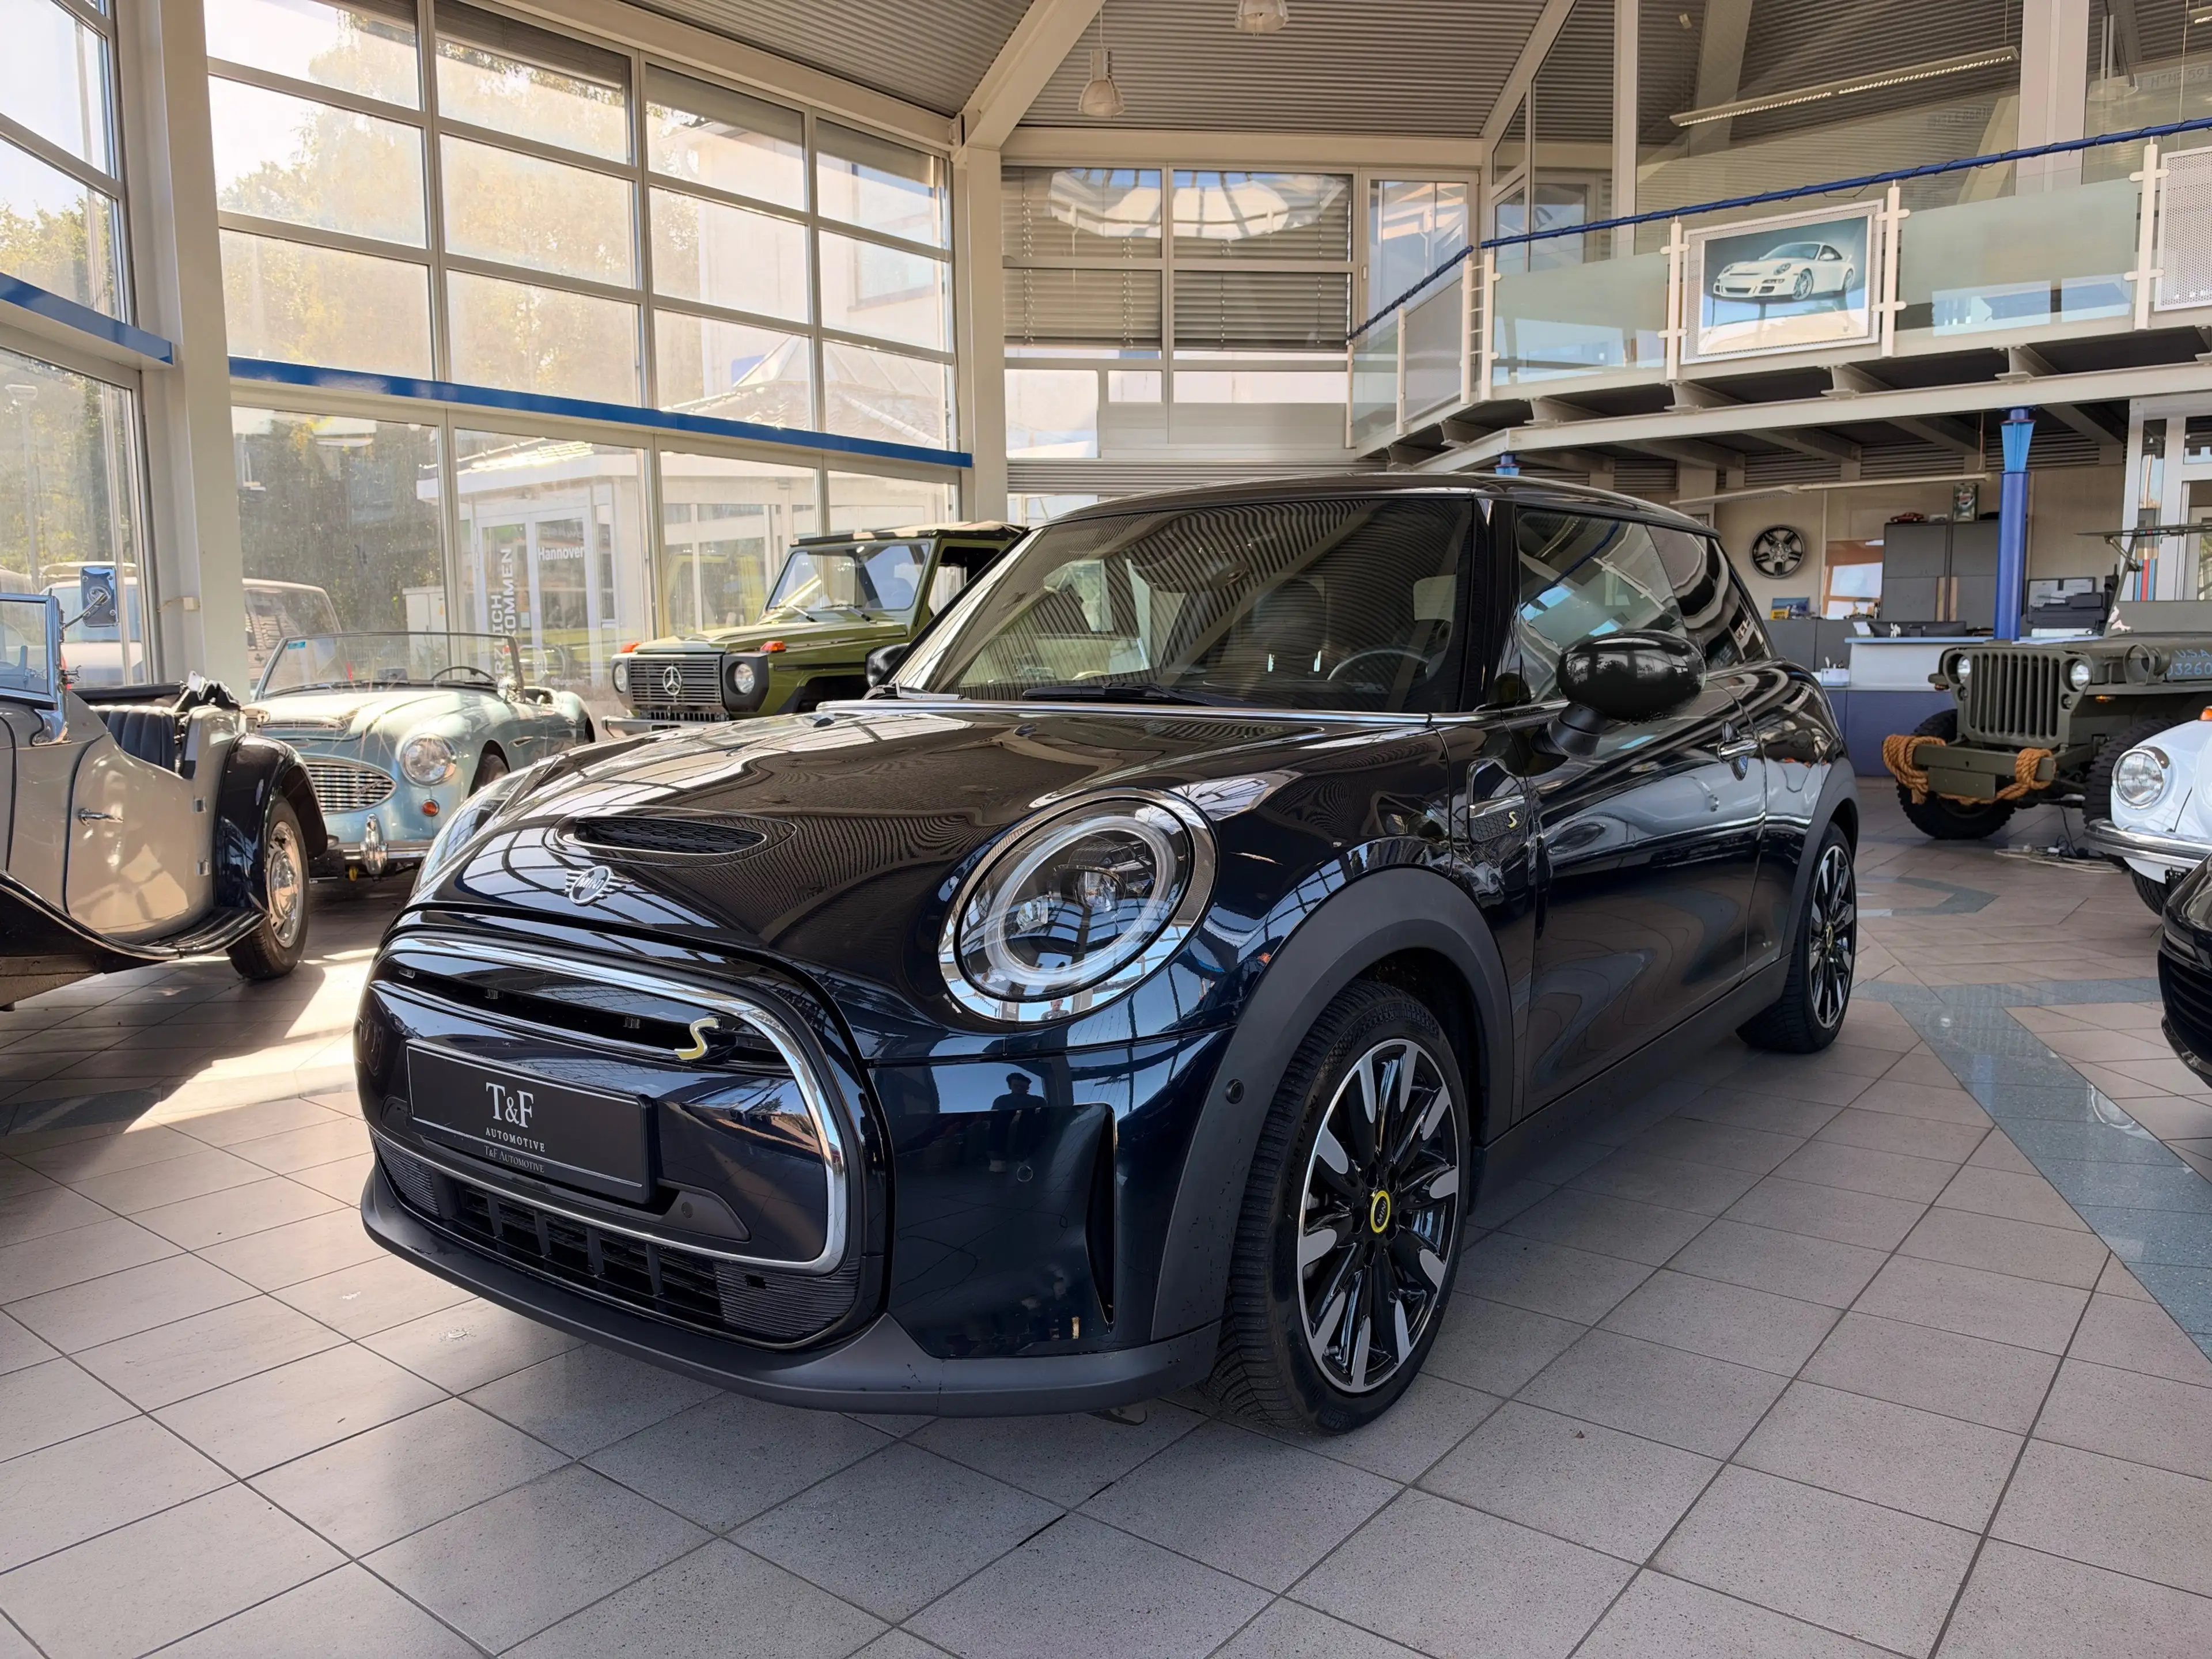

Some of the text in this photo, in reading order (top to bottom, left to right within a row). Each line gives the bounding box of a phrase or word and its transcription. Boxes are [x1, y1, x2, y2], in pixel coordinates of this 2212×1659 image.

[537, 545, 584, 560] Hannover
[1507, 810, 1518, 828] S
[575, 877, 604, 890] MINI
[674, 1017, 720, 1060] S
[486, 1082, 534, 1128] T&F
[486, 1127, 546, 1153] AUTOMOTIVE
[484, 1145, 545, 1173] T&F AUTOMOTIVE
[1376, 1200, 1388, 1225] MINI
